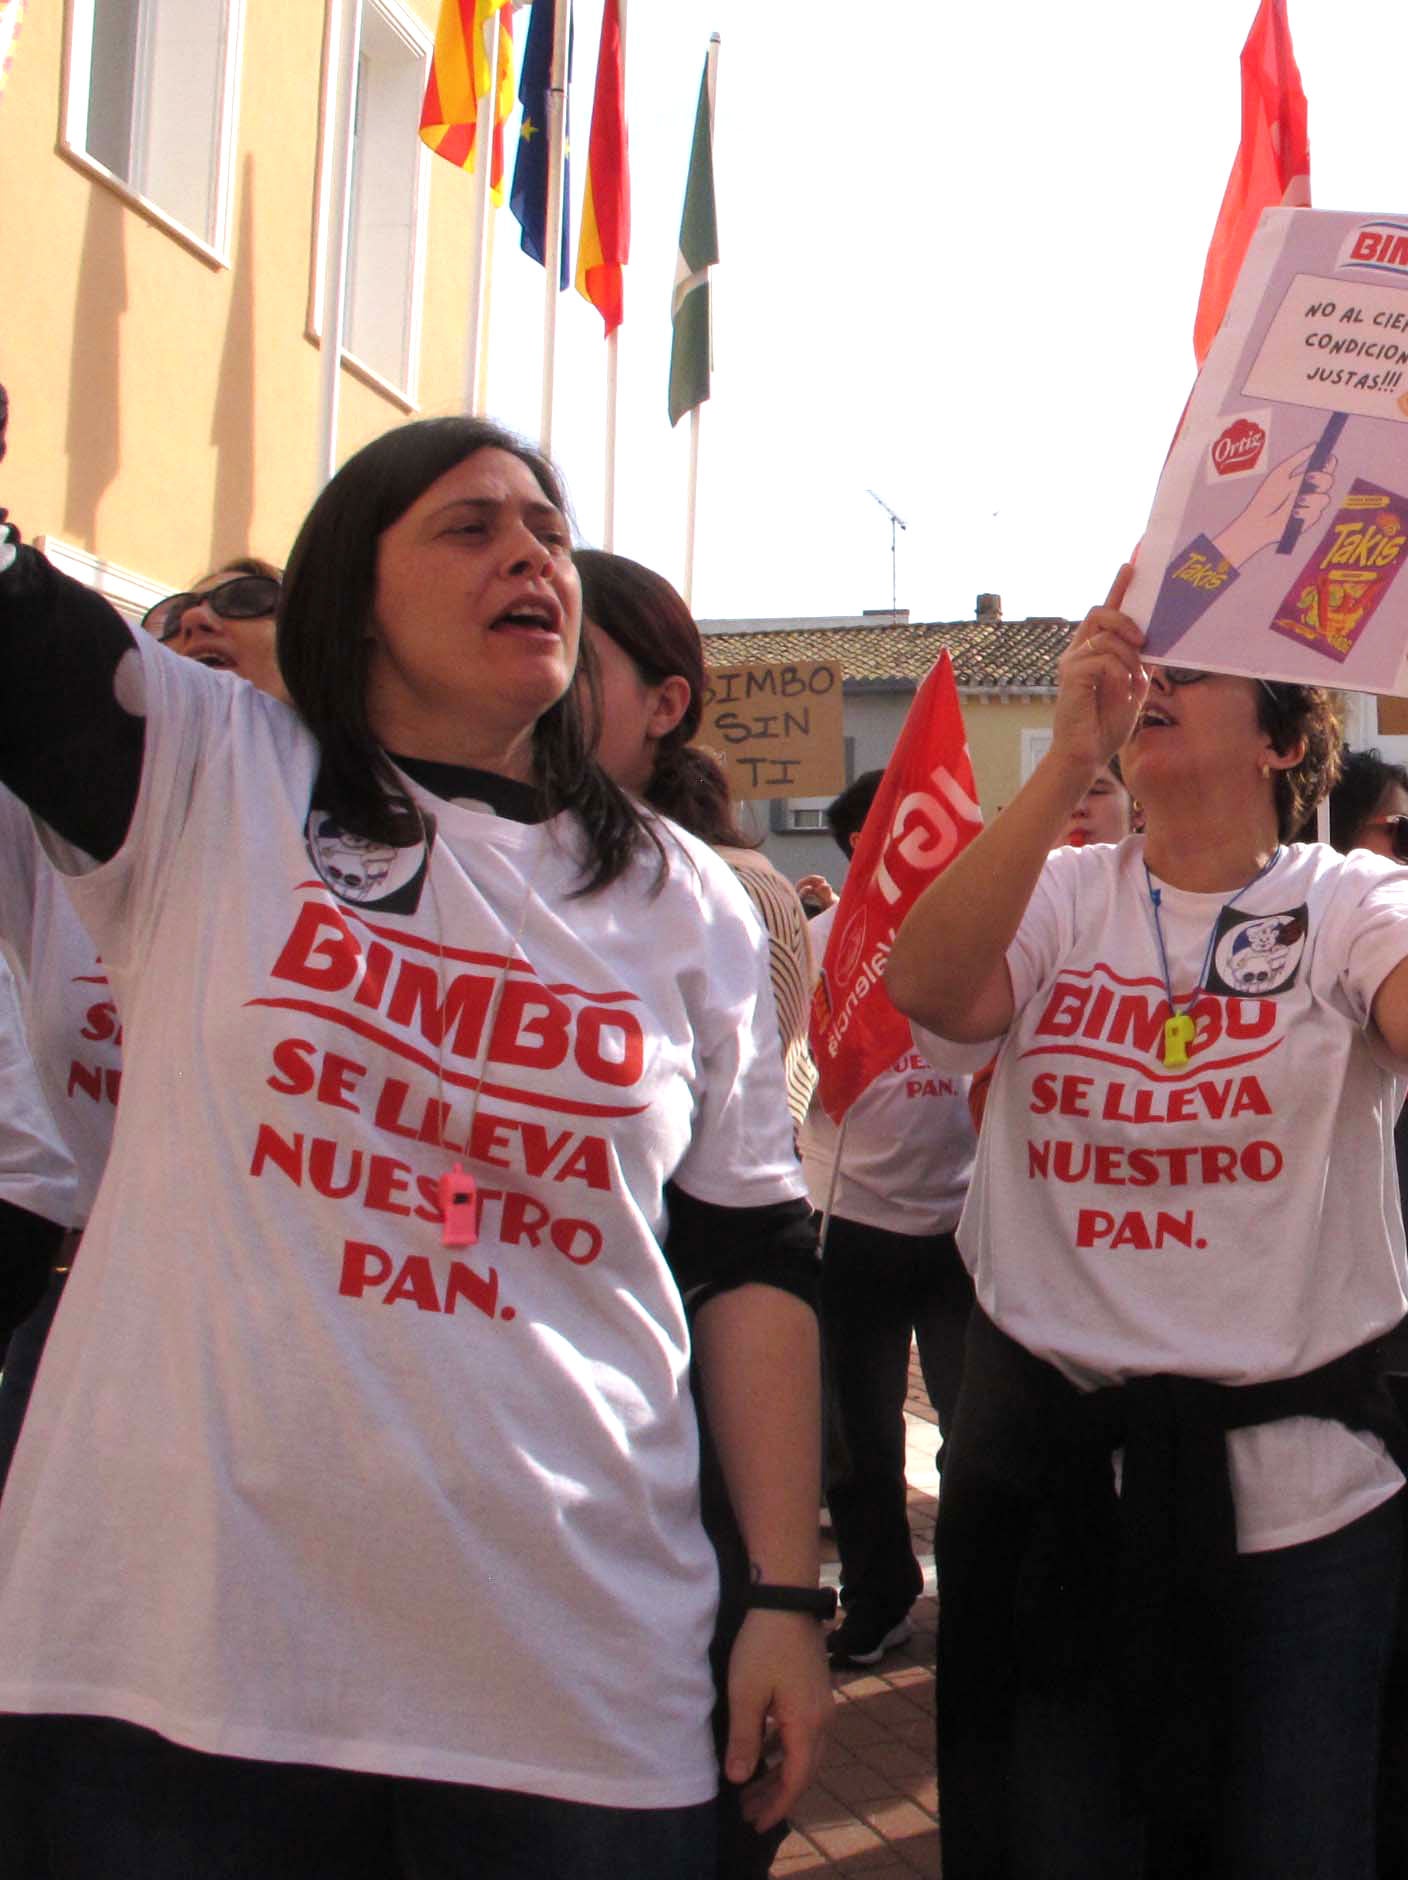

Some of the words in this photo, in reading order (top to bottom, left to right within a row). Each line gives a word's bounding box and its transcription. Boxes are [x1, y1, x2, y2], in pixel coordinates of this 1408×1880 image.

[1305, 302, 1336, 318] NO
[1339, 307, 1364, 323] AL
[1307, 367, 1402, 393] JUSTAS!!!
[1215, 427, 1263, 463] Ortiz
[1320, 522, 1407, 569] Takis
[1172, 552, 1228, 590] Takis
[714, 704, 810, 744] SIN
[736, 757, 801, 787] TI
[271, 901, 645, 1087] BIMBO
[267, 1038, 367, 1114] SE
[375, 1077, 612, 1191] LLEVA
[1029, 1073, 1094, 1117] SE
[1103, 1076, 1273, 1124] LLEVA
[1029, 1140, 1284, 1187] NUESTRO
[1076, 1209, 1208, 1250] PAN.
[339, 1239, 516, 1321] PAN.
